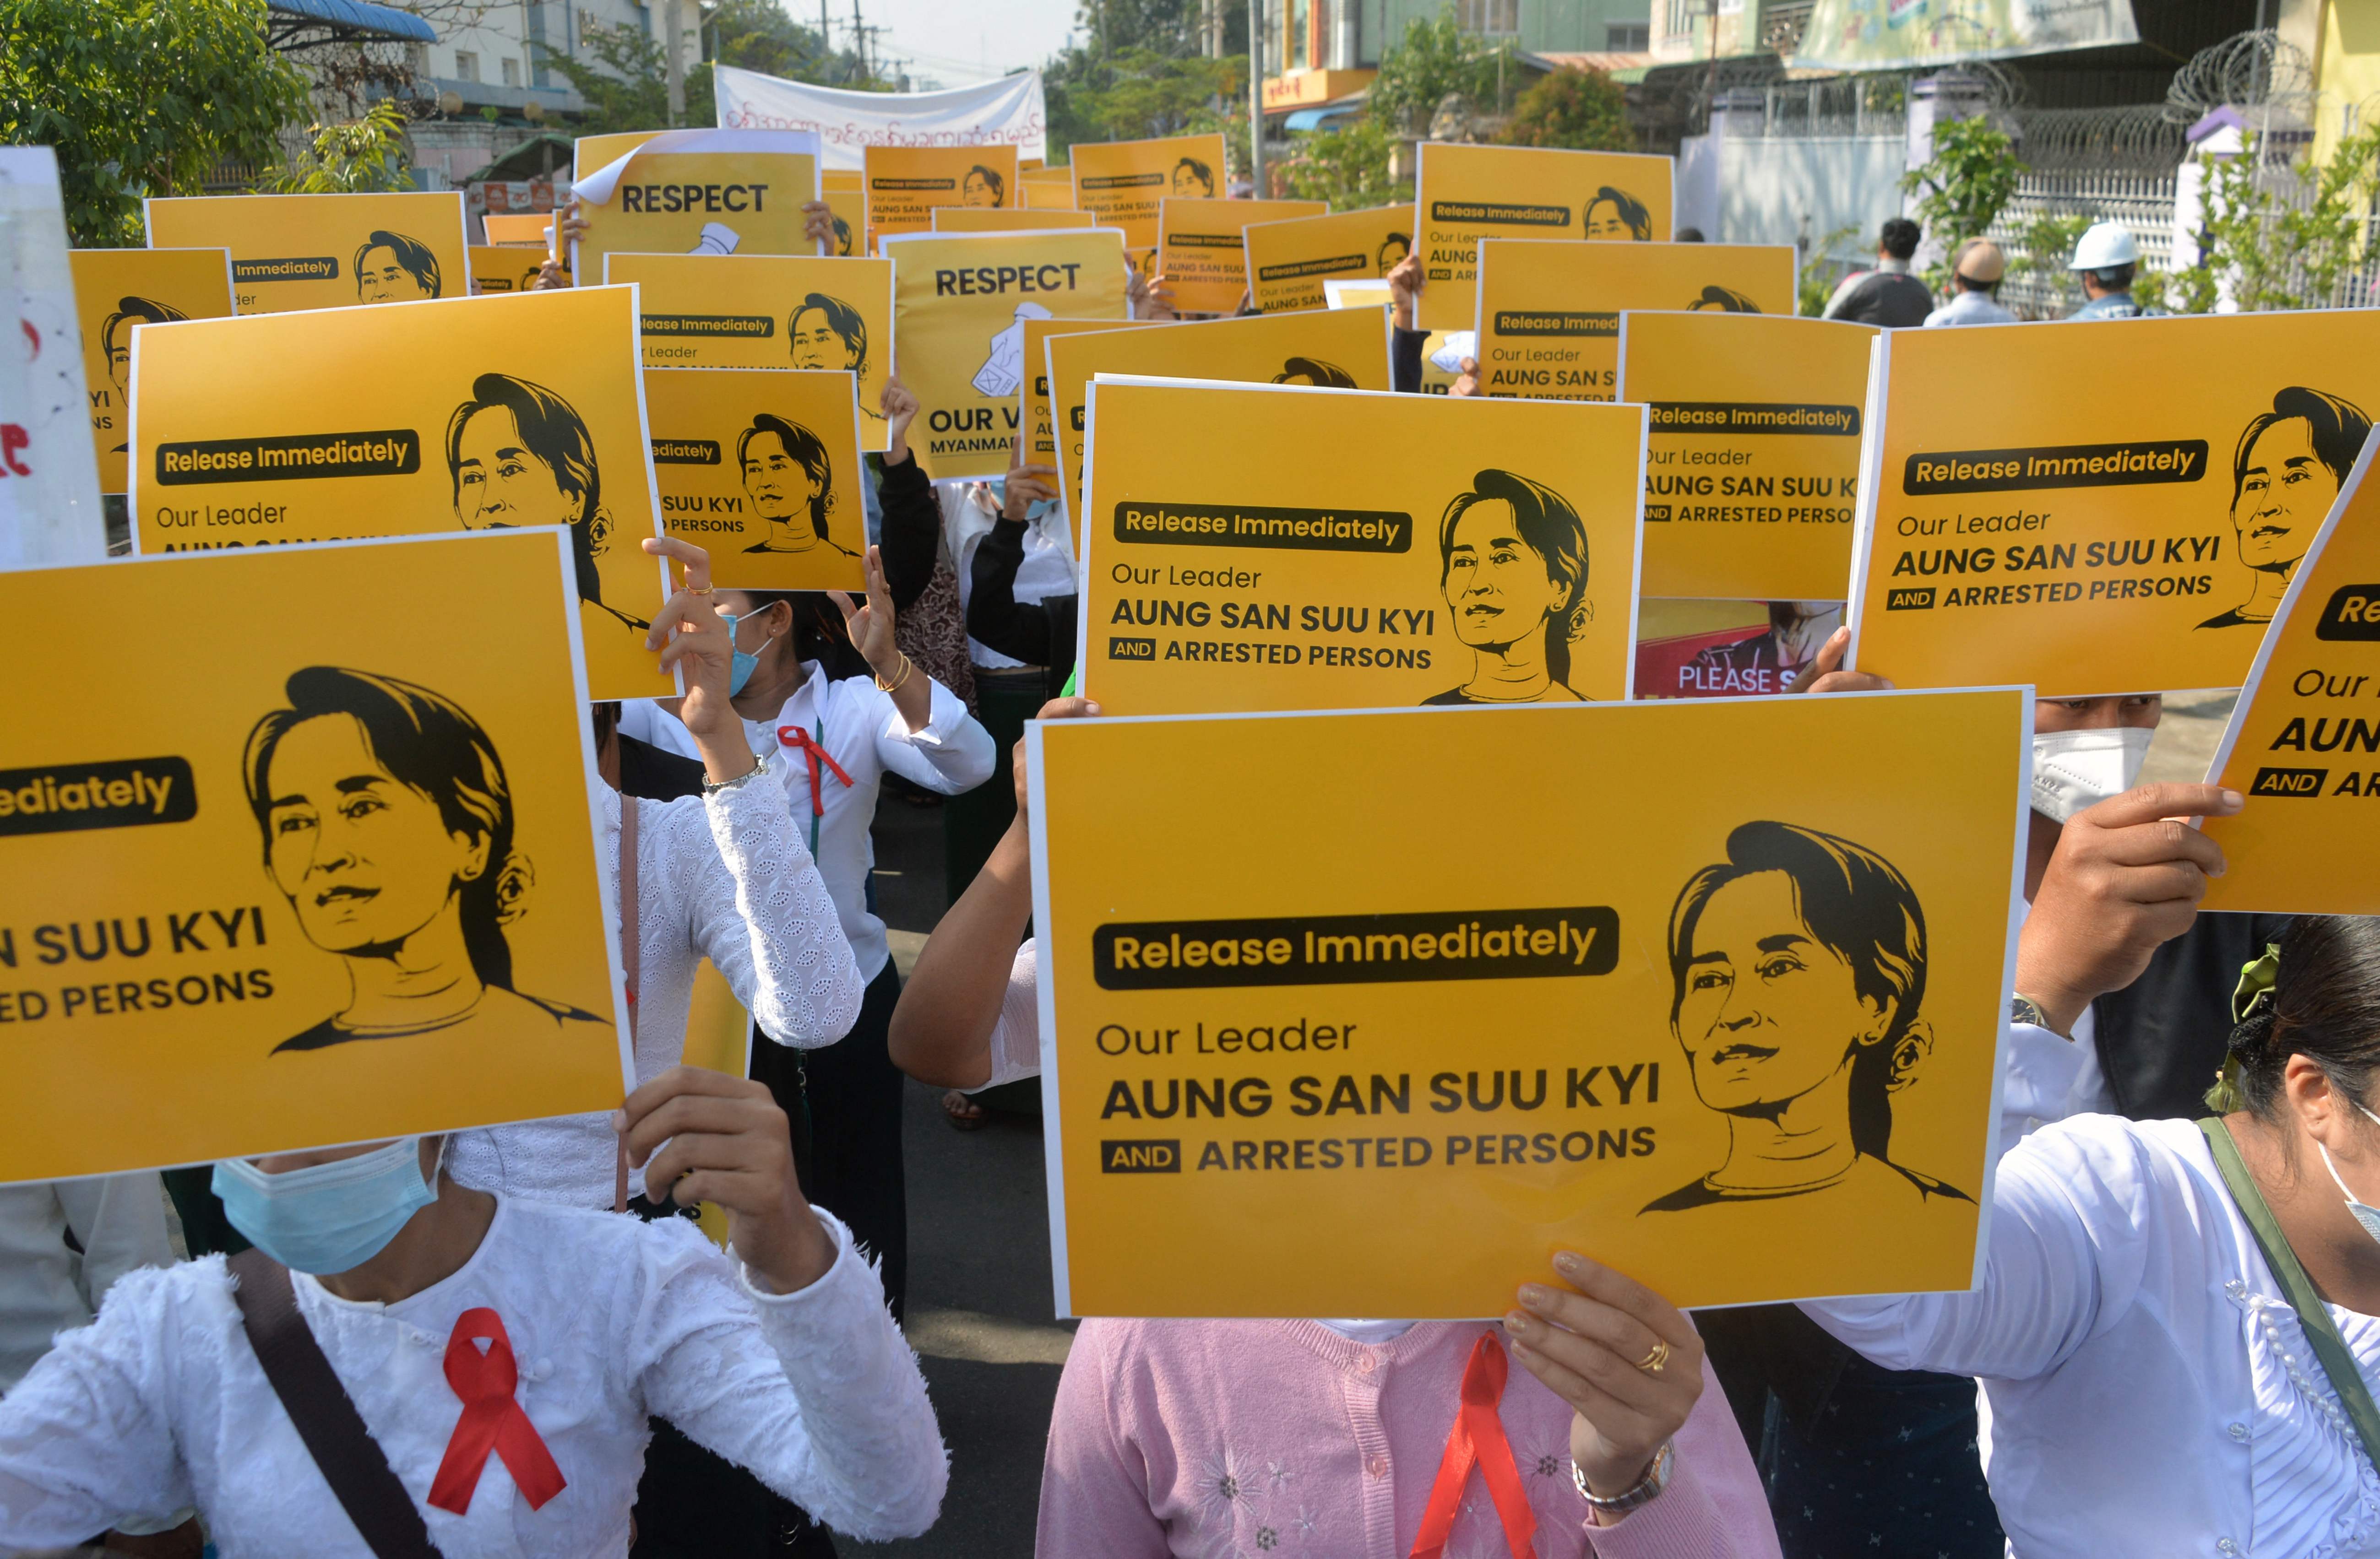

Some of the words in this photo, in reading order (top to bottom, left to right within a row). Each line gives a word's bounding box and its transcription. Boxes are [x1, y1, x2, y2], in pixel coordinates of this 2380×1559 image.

[623, 184, 768, 212] RESPECT
[1436, 205, 1485, 217] Release
[1488, 207, 1565, 223] Immediately
[1430, 231, 1453, 243] Our
[1262, 266, 1300, 277] Release
[1302, 257, 1363, 273] Immediately
[1430, 249, 1477, 263] AUNG
[236, 261, 331, 276] Immediately
[935, 264, 1081, 297] RESPECT
[235, 293, 256, 305] der
[1261, 288, 1277, 297] Our
[1281, 284, 1314, 295] Leader
[1263, 298, 1299, 311] AUNG
[641, 319, 679, 330] lease
[682, 319, 768, 334] Immediately
[1501, 315, 1561, 329] Release
[650, 346, 697, 357] Leader
[1492, 348, 1521, 361] Our
[1527, 348, 1580, 362] Leader
[1491, 369, 1550, 385] AUNG
[1556, 370, 1597, 386] SAN
[89, 391, 110, 407] YI
[1035, 406, 1051, 416] Ou
[929, 408, 993, 433] OUR
[1650, 407, 1727, 424] Release
[1732, 409, 1852, 431] Immediately
[165, 446, 252, 472] Release
[258, 439, 408, 468] Immediately
[652, 443, 713, 461] ediately
[1683, 449, 1752, 465] Leader
[1915, 459, 2021, 482] Release
[2027, 448, 2196, 476] Immediately
[1721, 476, 1774, 496] SAN
[1782, 477, 1832, 497] SUU
[157, 506, 198, 528] Our
[206, 503, 287, 527] Leader
[663, 496, 703, 511] SUU
[709, 497, 742, 513] KYI
[1678, 506, 1782, 523] ARRESTED
[1788, 508, 1856, 523] PERSO
[671, 519, 744, 532] PERSONS
[1126, 510, 1227, 534] Release
[1234, 514, 1400, 546] Immediately
[1897, 516, 1948, 536] Our
[1956, 510, 2051, 534] Leader
[1891, 547, 1995, 577] AUNG
[2004, 543, 2076, 572] SAN
[2085, 539, 2155, 568] SUU
[2163, 536, 2221, 563] KYI
[1111, 563, 1160, 584] Our
[1169, 565, 1261, 588] Leader
[1892, 591, 1931, 606] AND
[1943, 582, 2083, 607] ARRESTED
[2089, 575, 2212, 600] PERSONS
[1110, 598, 1212, 628] AUNG
[1220, 602, 1290, 630] SAN
[1300, 605, 1369, 633] SUU
[1379, 609, 1435, 636] KYI
[1114, 642, 1152, 657] AND
[1164, 640, 1301, 665] ARRESTED
[1308, 645, 1432, 670] PERSONS
[1679, 666, 1771, 693] PLEASE
[2293, 669, 2369, 698] Our
[2268, 718, 2380, 752] AUN
[0, 771, 173, 817] ediately
[2260, 774, 2317, 792] AND
[34, 917, 151, 964] SUU
[169, 906, 267, 954] KYI
[1114, 934, 1292, 969] Release
[1305, 920, 1597, 965] Immediately
[61, 969, 274, 1018] PERSONS
[1096, 1024, 1180, 1056] Our
[1196, 1017, 1358, 1054] Leader
[1101, 1077, 1273, 1120] AUNG
[1289, 1072, 1411, 1116] SAN
[1429, 1068, 1547, 1114] SUU
[1565, 1062, 1660, 1108] KYI
[1111, 1146, 1173, 1168] AND
[1197, 1137, 1433, 1171] ARRESTED
[1445, 1126, 1657, 1165] PERSONS
